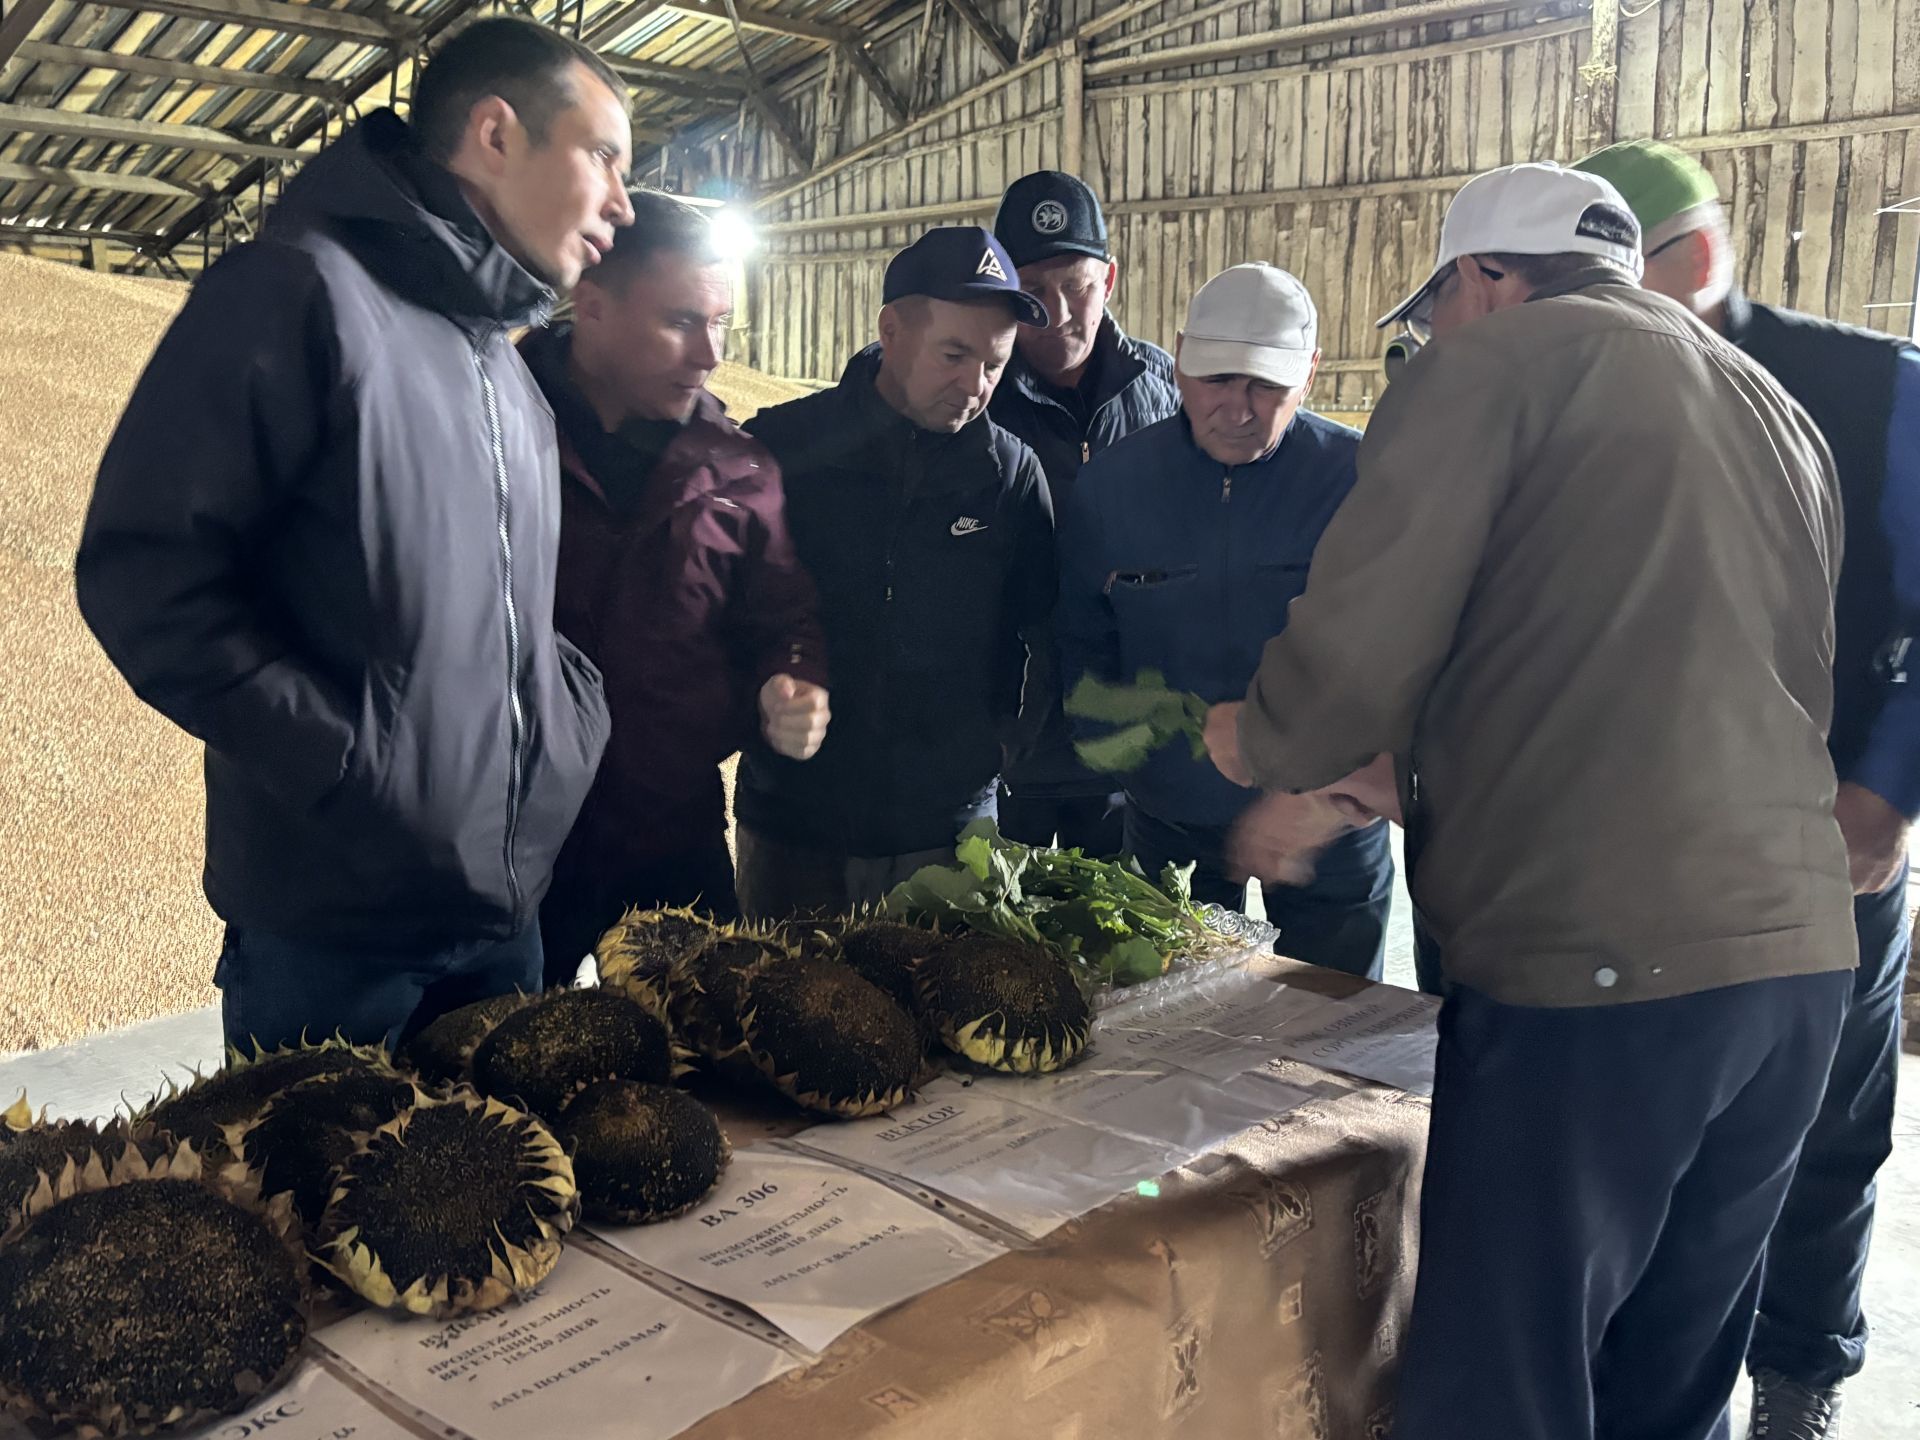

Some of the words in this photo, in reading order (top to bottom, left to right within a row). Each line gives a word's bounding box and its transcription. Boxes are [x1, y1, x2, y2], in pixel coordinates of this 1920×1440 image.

[955, 515, 979, 529] NIKE
[875, 1105, 957, 1141] ВЕКТОР
[736, 1181, 779, 1209] 306
[698, 1186, 849, 1263] ПРОДОЛЖИТЕЛЬНОСТЬ
[808, 1216, 843, 1240] ДНЕЙ
[711, 1231, 792, 1268] ВЕГЕТАЦИИ
[762, 1271, 798, 1288] ДАТА
[868, 1225, 900, 1242] МАЯ
[427, 1288, 612, 1375] ПРОДОЛЖИТЕЛЬНОСТЬ
[557, 1317, 599, 1343] ДНЕЙ
[439, 1334, 538, 1382] ВЕГЕТАЦИИ
[491, 1388, 534, 1411] ДАТА
[533, 1355, 602, 1390] ПОСЕВА
[600, 1340, 631, 1357] 9-10
[629, 1322, 667, 1341] МАЯ
